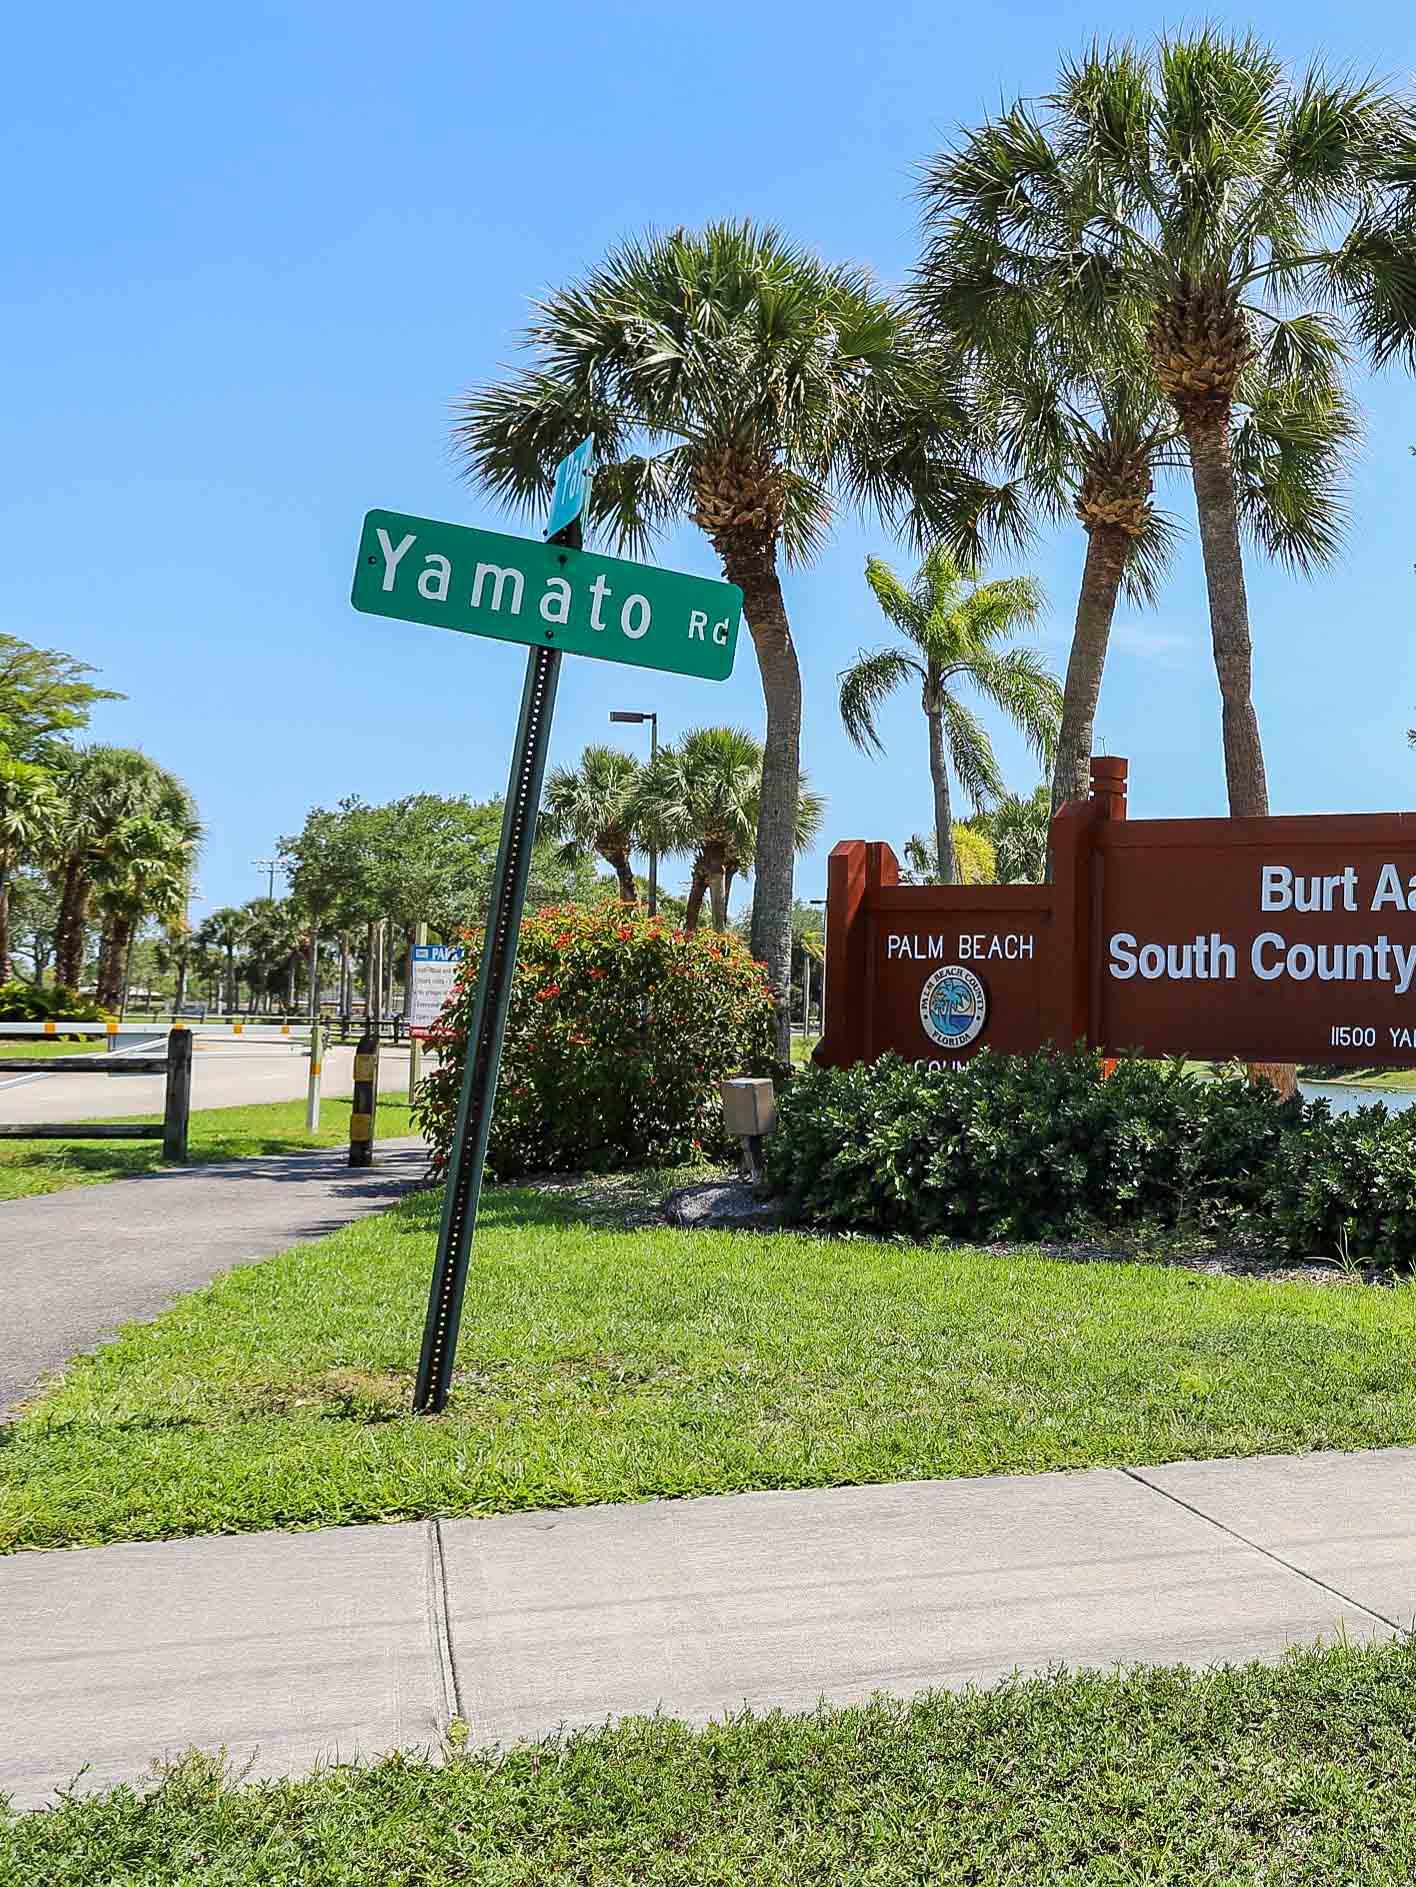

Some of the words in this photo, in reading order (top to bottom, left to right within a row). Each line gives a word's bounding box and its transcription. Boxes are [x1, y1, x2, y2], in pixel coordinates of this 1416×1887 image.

[376, 528, 651, 640] Yamato
[689, 611, 729, 645] Rd
[1262, 866, 1358, 912] Burt
[888, 935, 943, 959] PALM
[959, 935, 1032, 959] BEACH
[1109, 933, 1235, 979] South
[934, 968, 963, 981] BEACH
[964, 973, 983, 1012] COUNTY
[932, 1030, 971, 1046] FLORIDA
[1332, 1026, 1375, 1046] 11500
